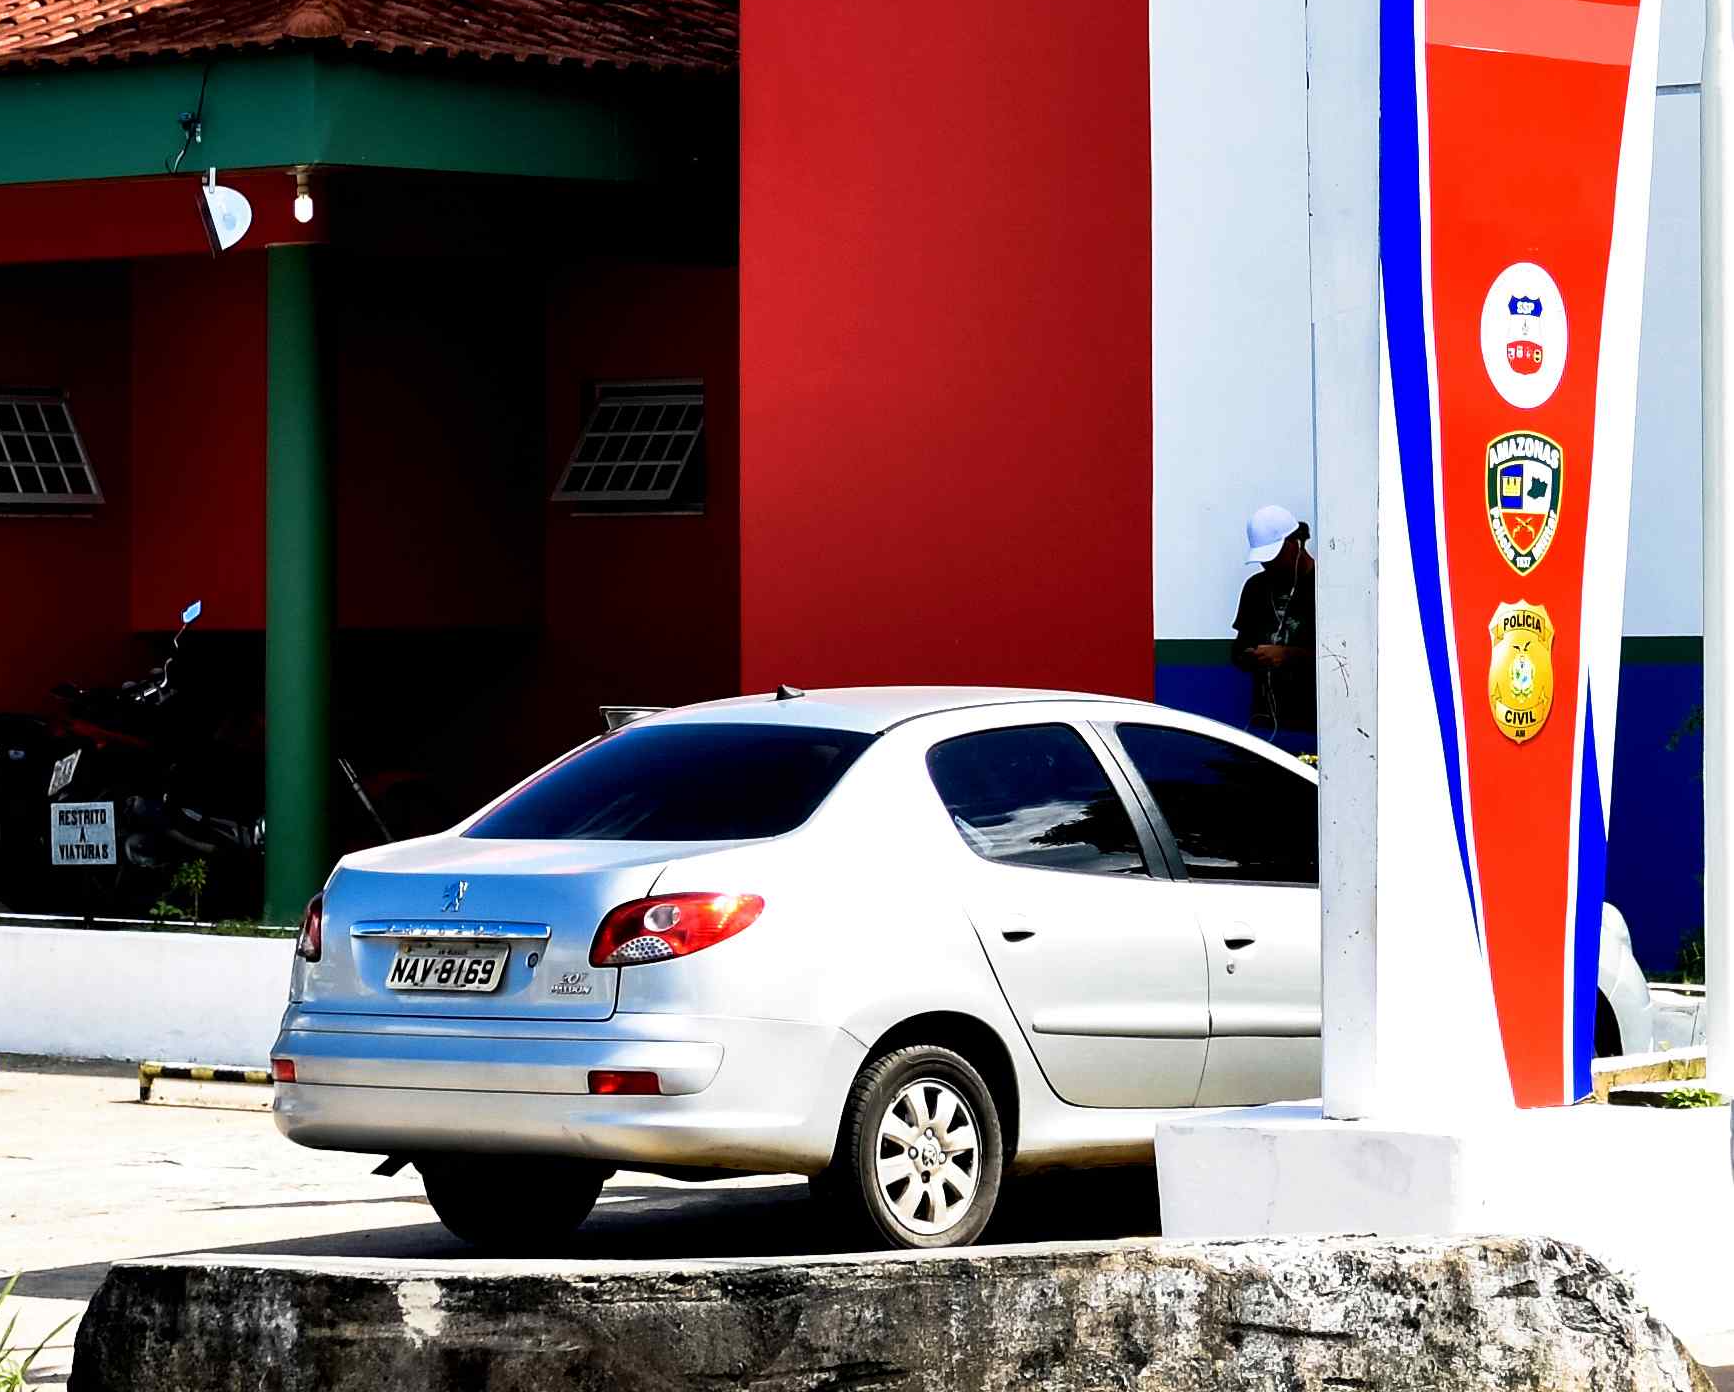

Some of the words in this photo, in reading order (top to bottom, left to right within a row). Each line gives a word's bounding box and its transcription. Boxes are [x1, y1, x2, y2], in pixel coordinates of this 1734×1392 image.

[1489, 437, 1560, 469] AMAZONAS
[1504, 710, 1536, 725] CIVIL
[58, 808, 107, 826] RESTRITO
[59, 844, 109, 860] VIATURAS
